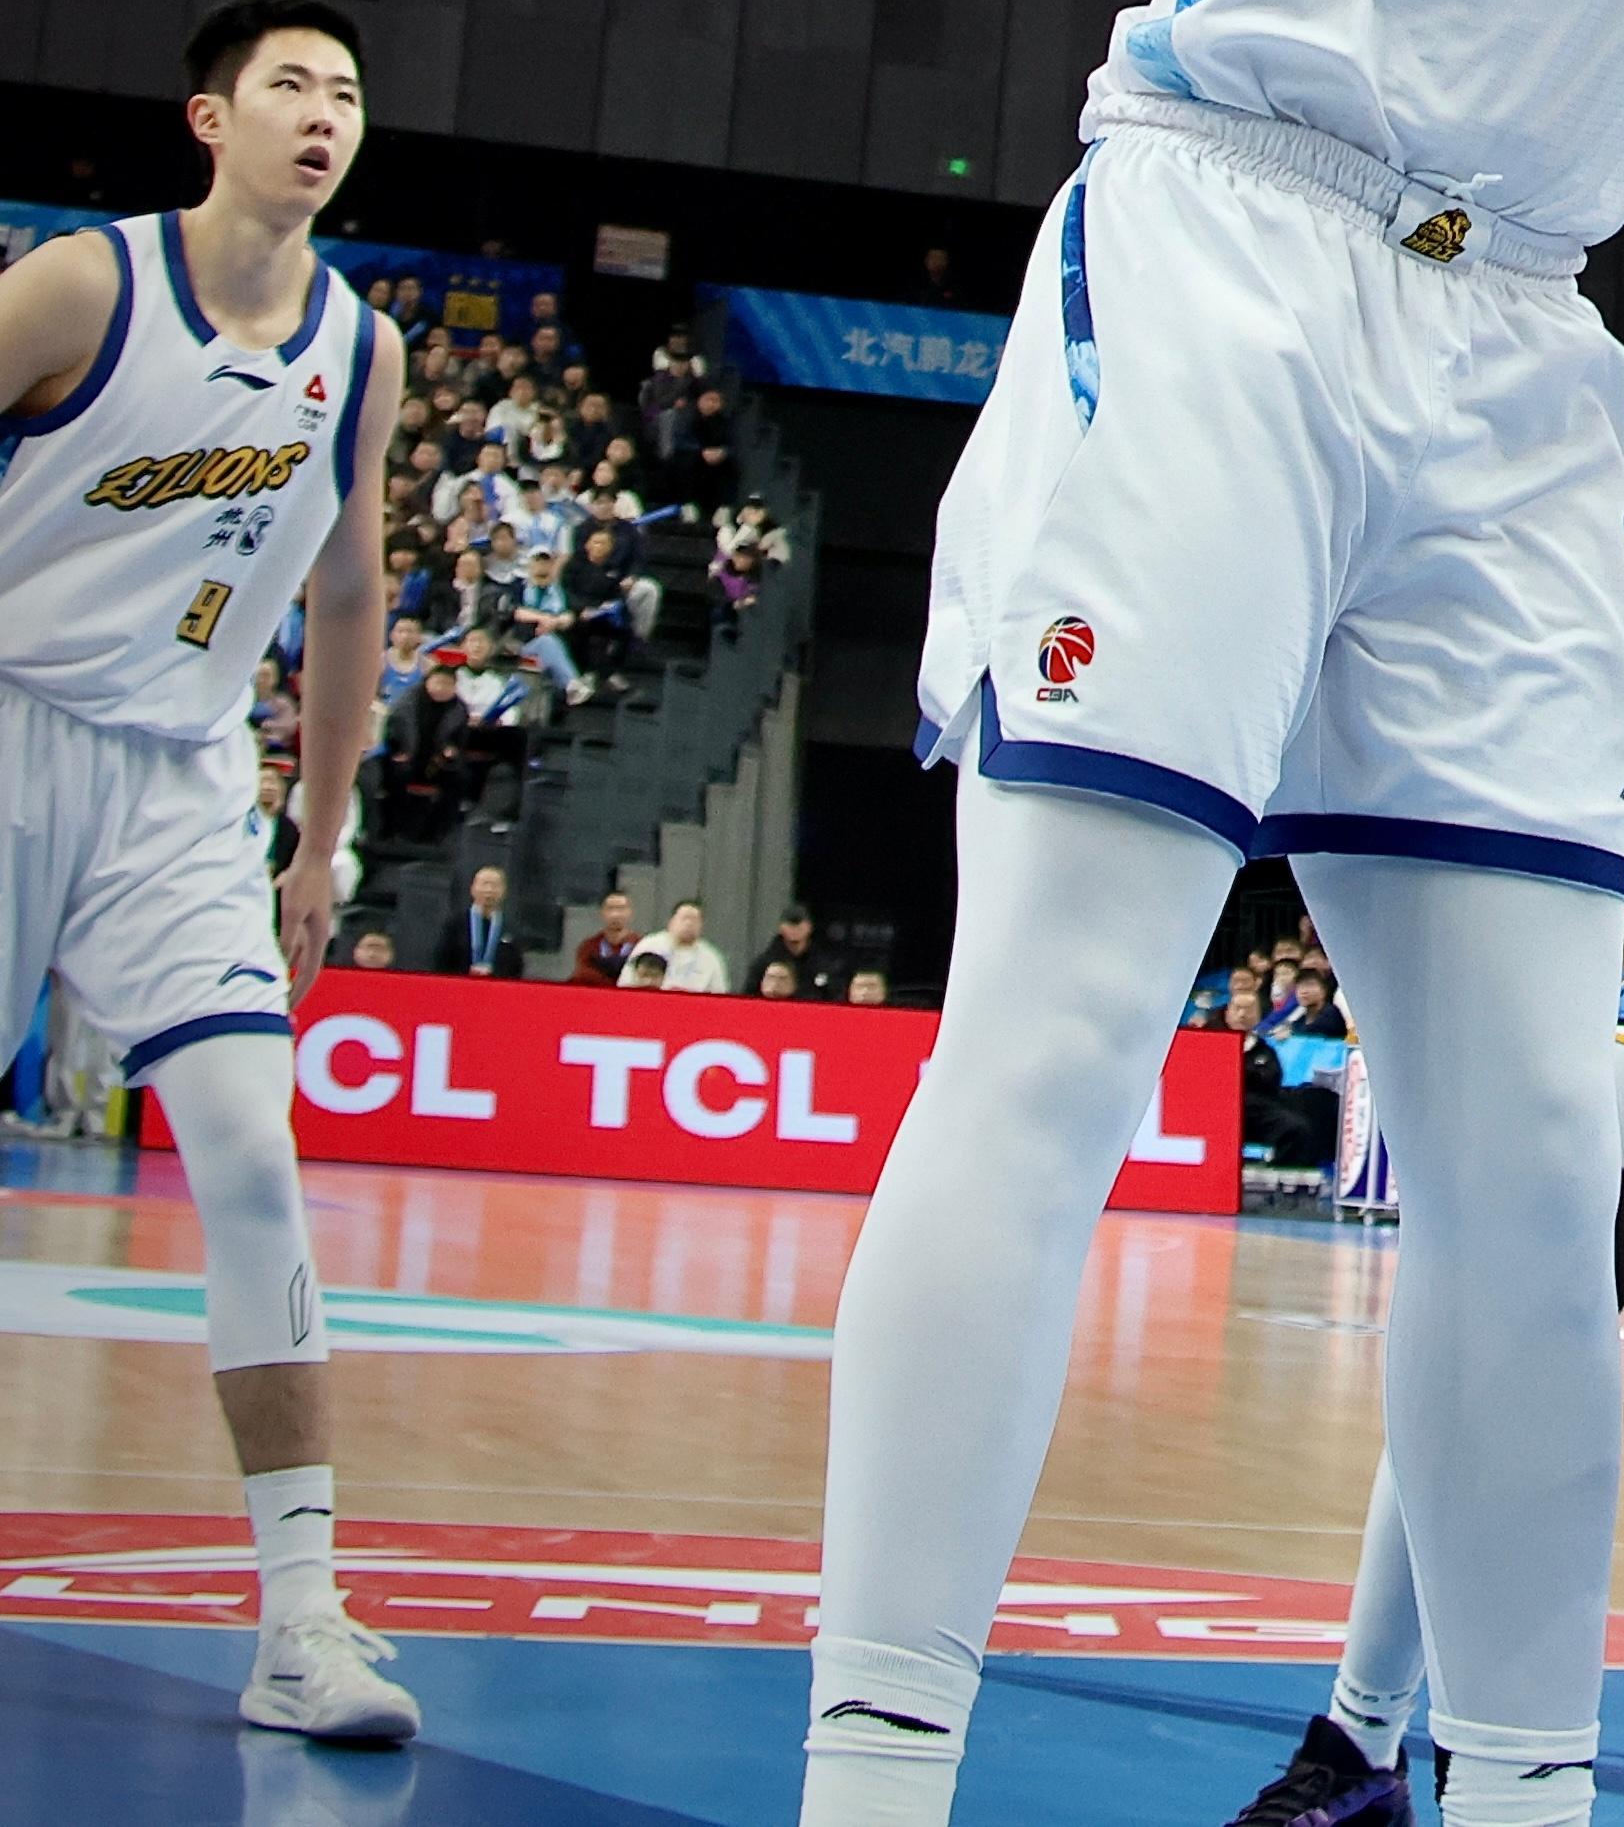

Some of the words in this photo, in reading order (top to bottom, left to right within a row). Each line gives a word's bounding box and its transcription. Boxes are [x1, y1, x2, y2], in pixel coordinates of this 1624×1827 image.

[176, 579, 234, 652] 9
[1036, 688, 1079, 703] CBA
[559, 1033, 859, 1144] TCL
